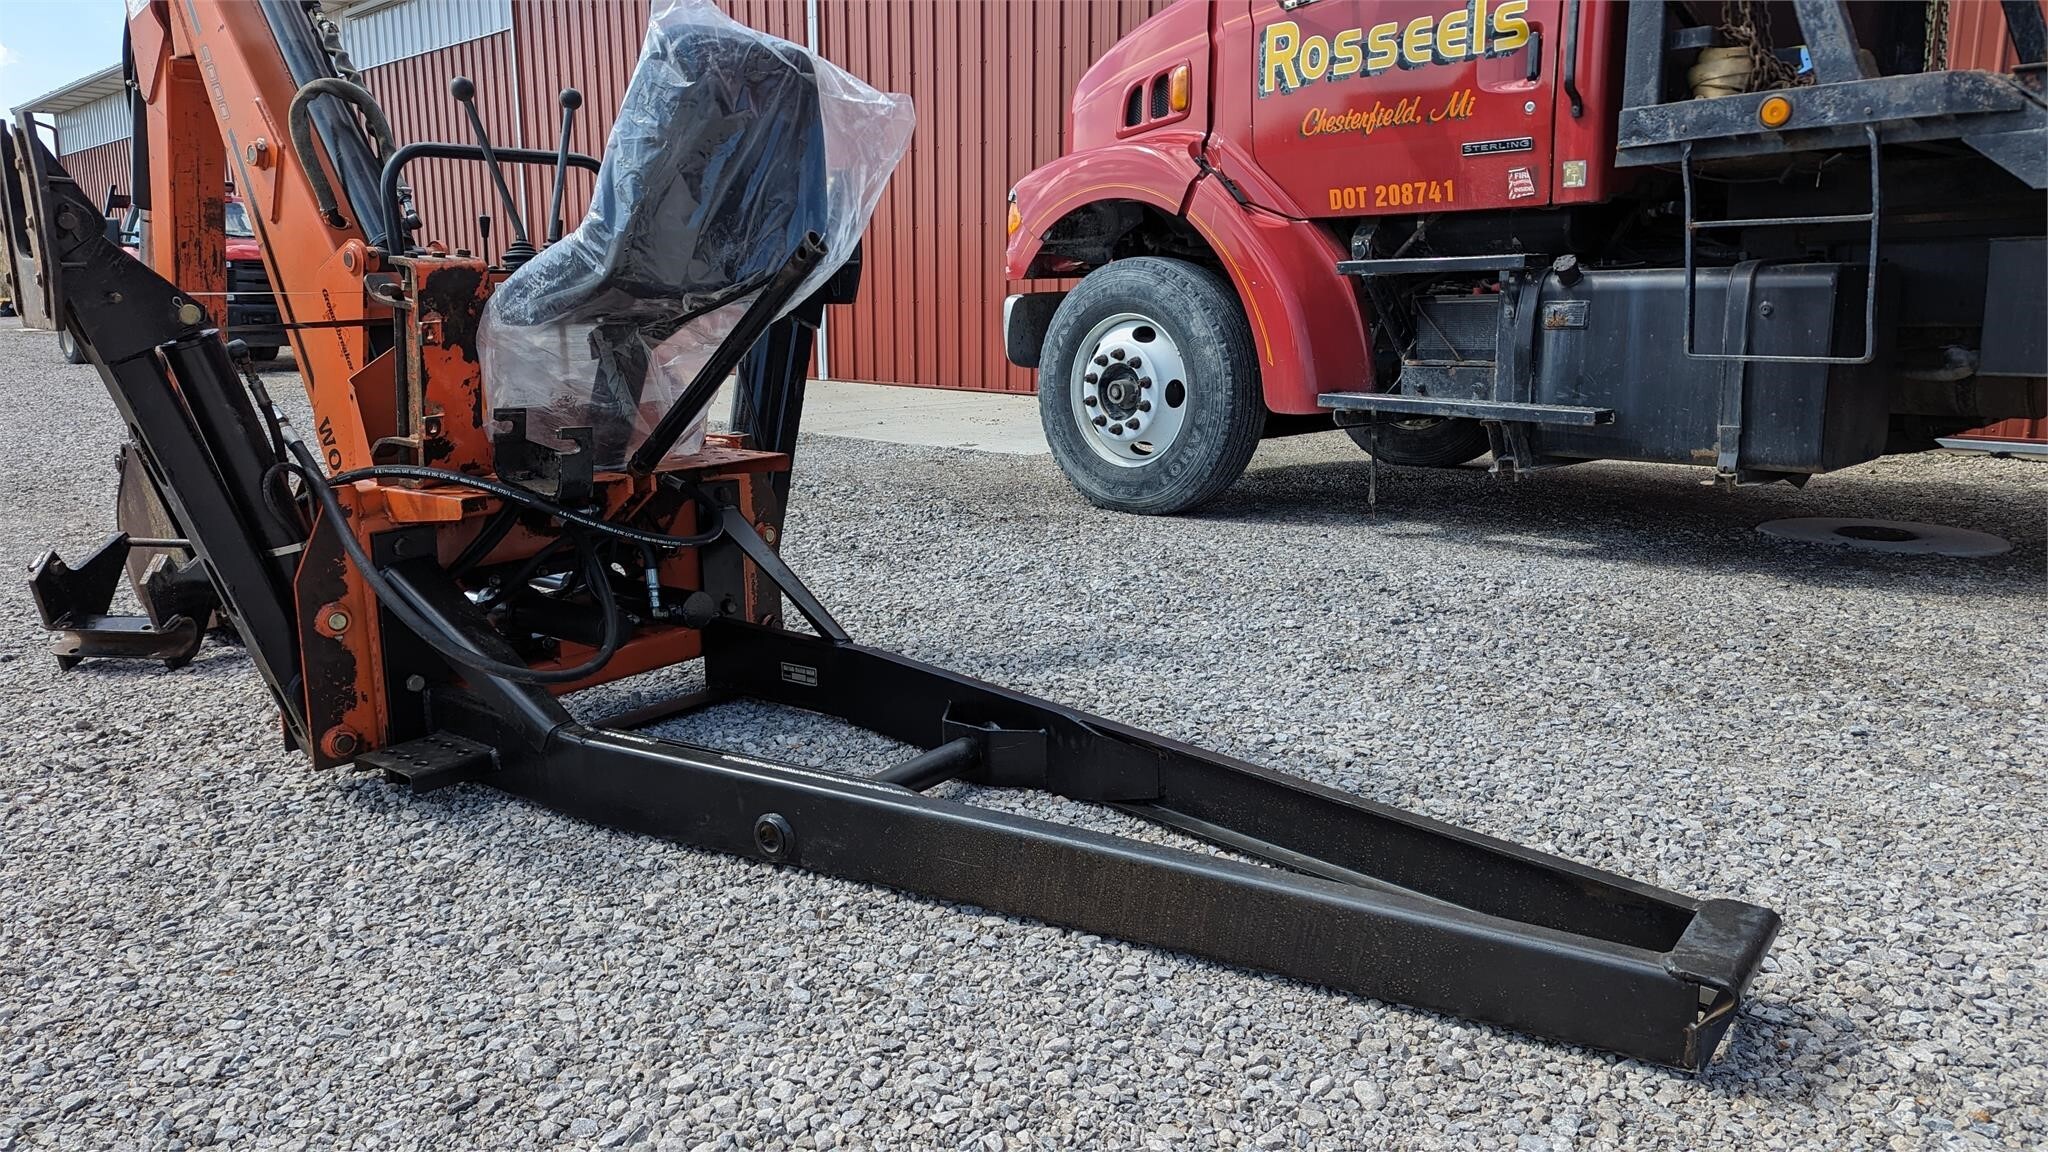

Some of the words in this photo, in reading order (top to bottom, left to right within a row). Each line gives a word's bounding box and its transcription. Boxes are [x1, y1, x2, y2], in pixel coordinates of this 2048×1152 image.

[1262, 0, 1531, 95] Rosseels
[1302, 97, 1422, 138] Chesterfield,
[1430, 89, 1476, 119] Mi
[1463, 139, 1531, 153] STERLING
[1329, 186, 1367, 210] DOT
[1375, 180, 1454, 207] 208741
[322, 288, 355, 371] Grounbreaker
[318, 415, 345, 475] WO
